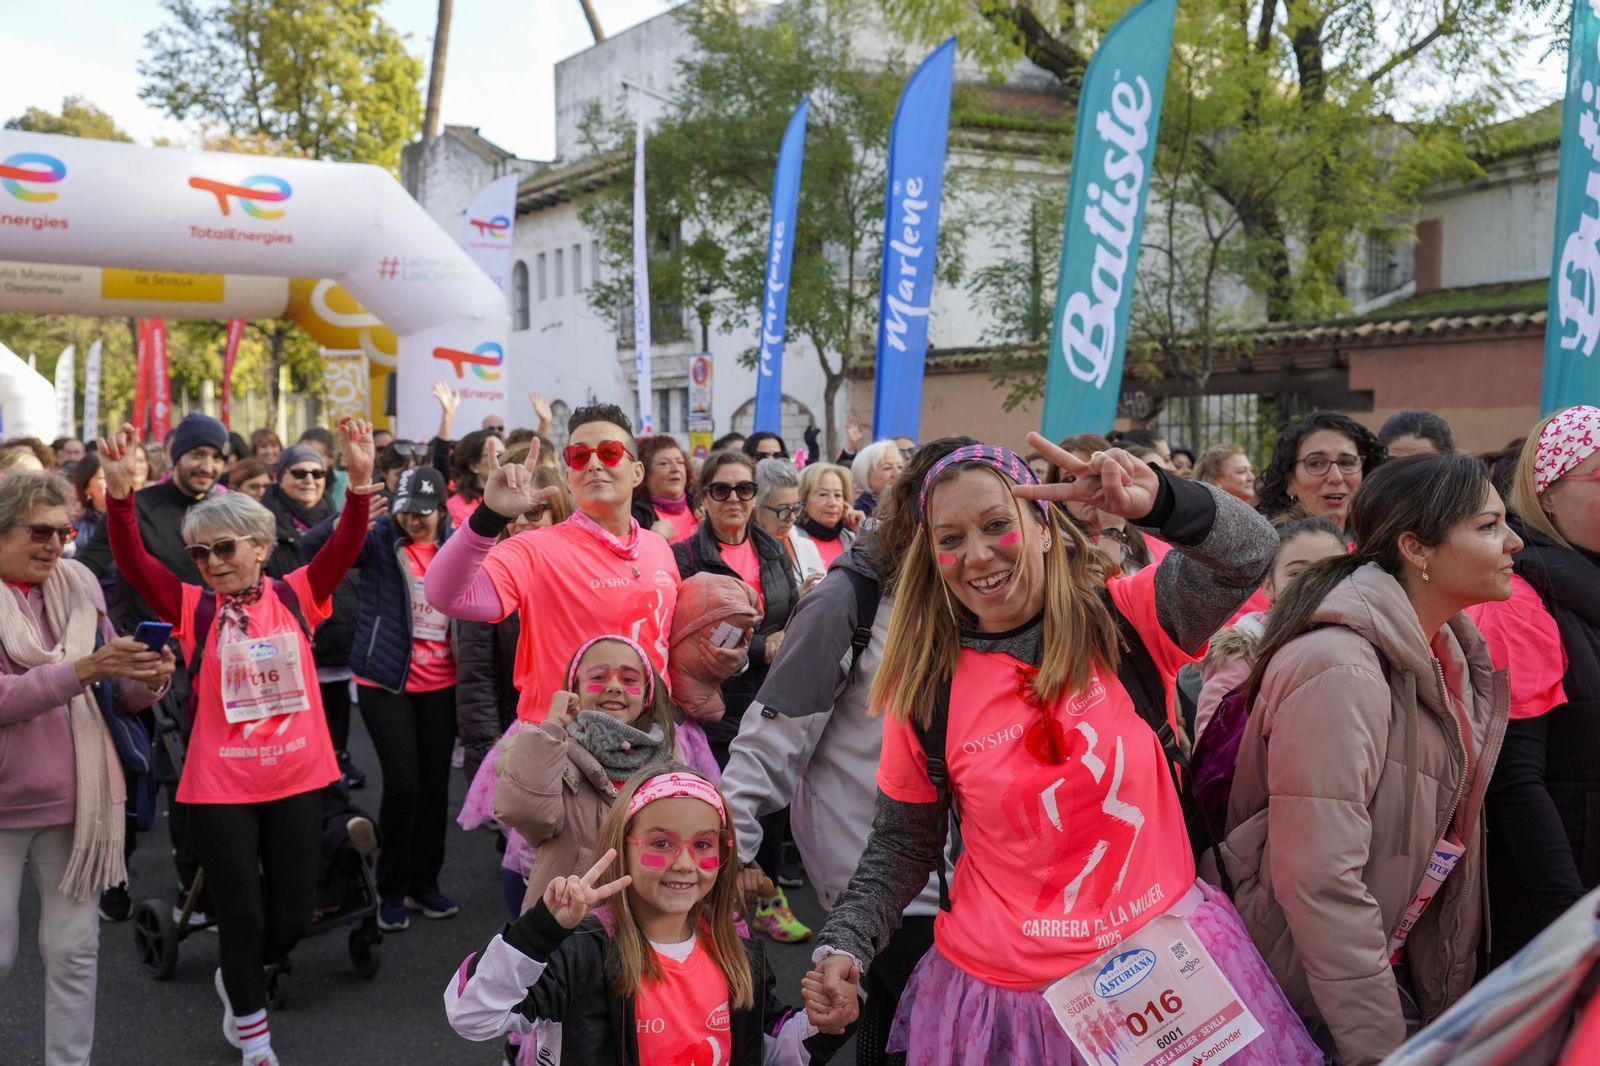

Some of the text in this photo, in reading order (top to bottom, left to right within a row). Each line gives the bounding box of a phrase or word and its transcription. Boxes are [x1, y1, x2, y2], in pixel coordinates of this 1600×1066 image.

[188, 225, 294, 245] TotalEnergies
[1061, 74, 1153, 390] Batiste
[20, 267, 82, 284] Municipal
[885, 175, 931, 353] Marlene
[4, 281, 64, 296] Deportes
[590, 577, 630, 589] OYSHO
[219, 736, 307, 759] CARRERA DE LA MUJER
[962, 723, 1024, 755] OYSHO
[1022, 882, 1165, 938] CARRERA DE LA MUJER
[1095, 929, 1122, 950] 2025
[1098, 955, 1154, 996] ASTURIANA
[1062, 990, 1091, 1011] TU DORSAL
[1067, 995, 1097, 1018] SUMA
[1125, 988, 1183, 1037] 016
[1155, 1014, 1227, 1066] DE LA MUJER SEVILLA
[1156, 1026, 1184, 1050] 6001
[1201, 1028, 1242, 1062] Santander
